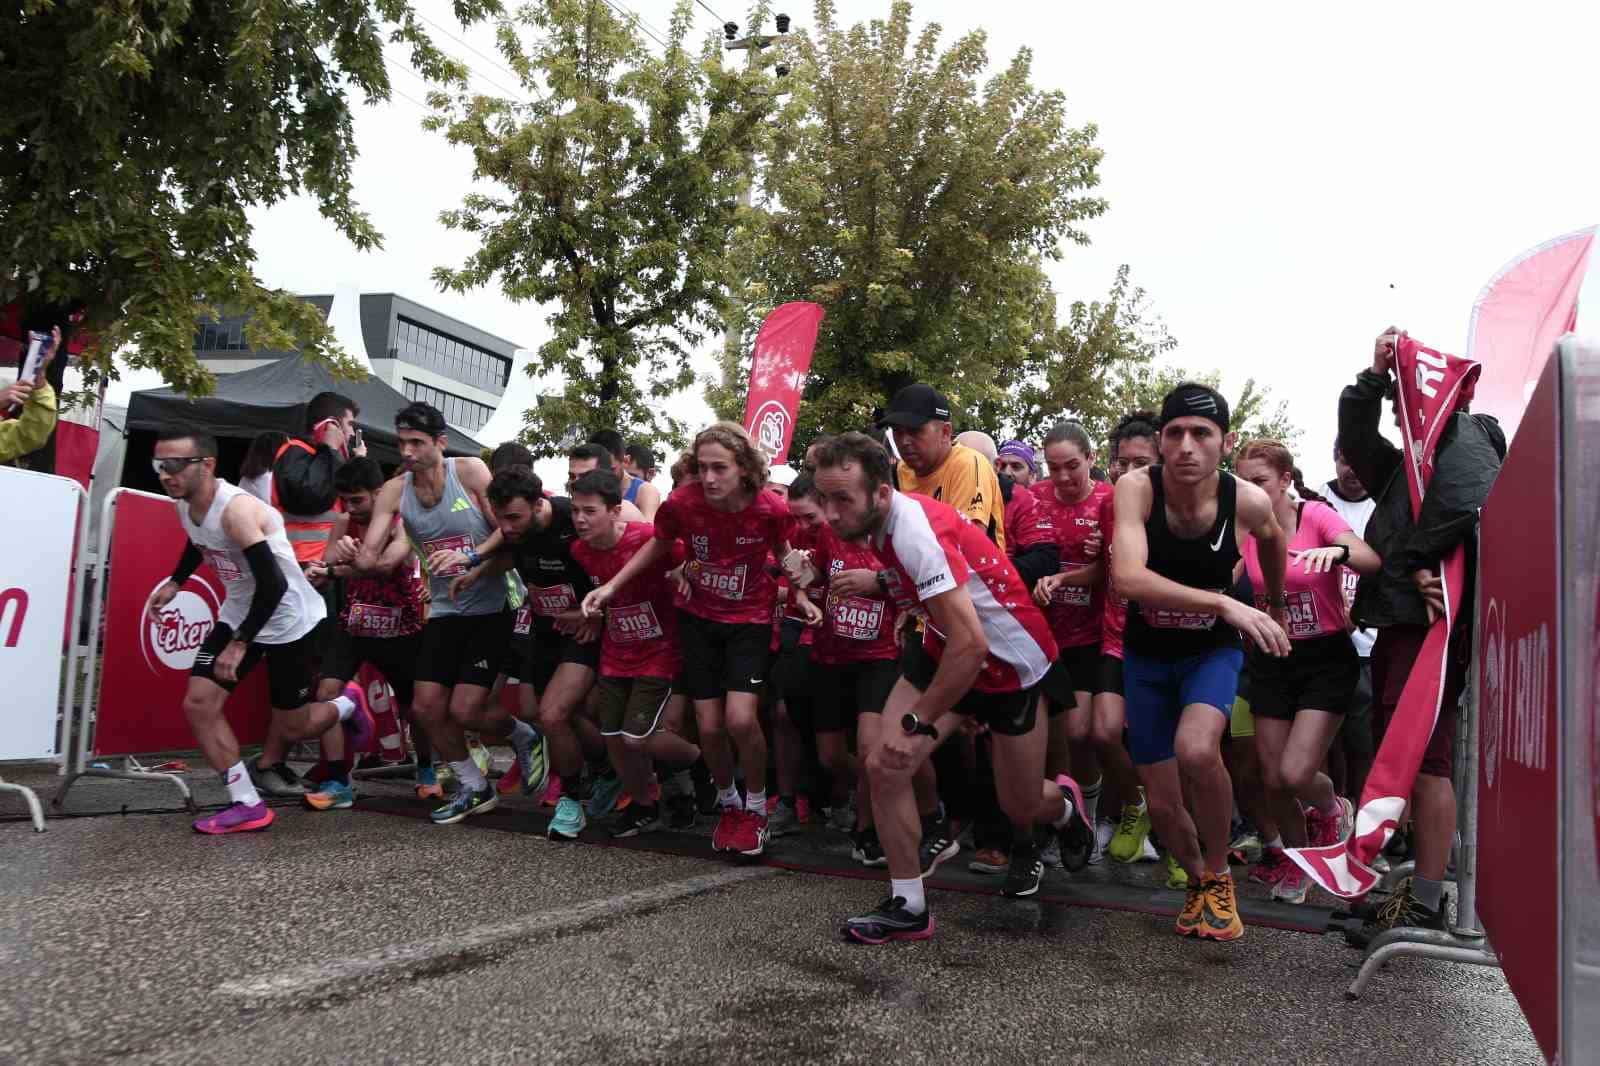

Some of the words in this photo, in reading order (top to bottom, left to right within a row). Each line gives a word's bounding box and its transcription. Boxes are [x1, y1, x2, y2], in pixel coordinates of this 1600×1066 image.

[701, 572, 739, 591] 3166
[363, 615, 396, 629] 3521
[618, 614, 650, 632] 3119
[837, 606, 878, 629] 3499
